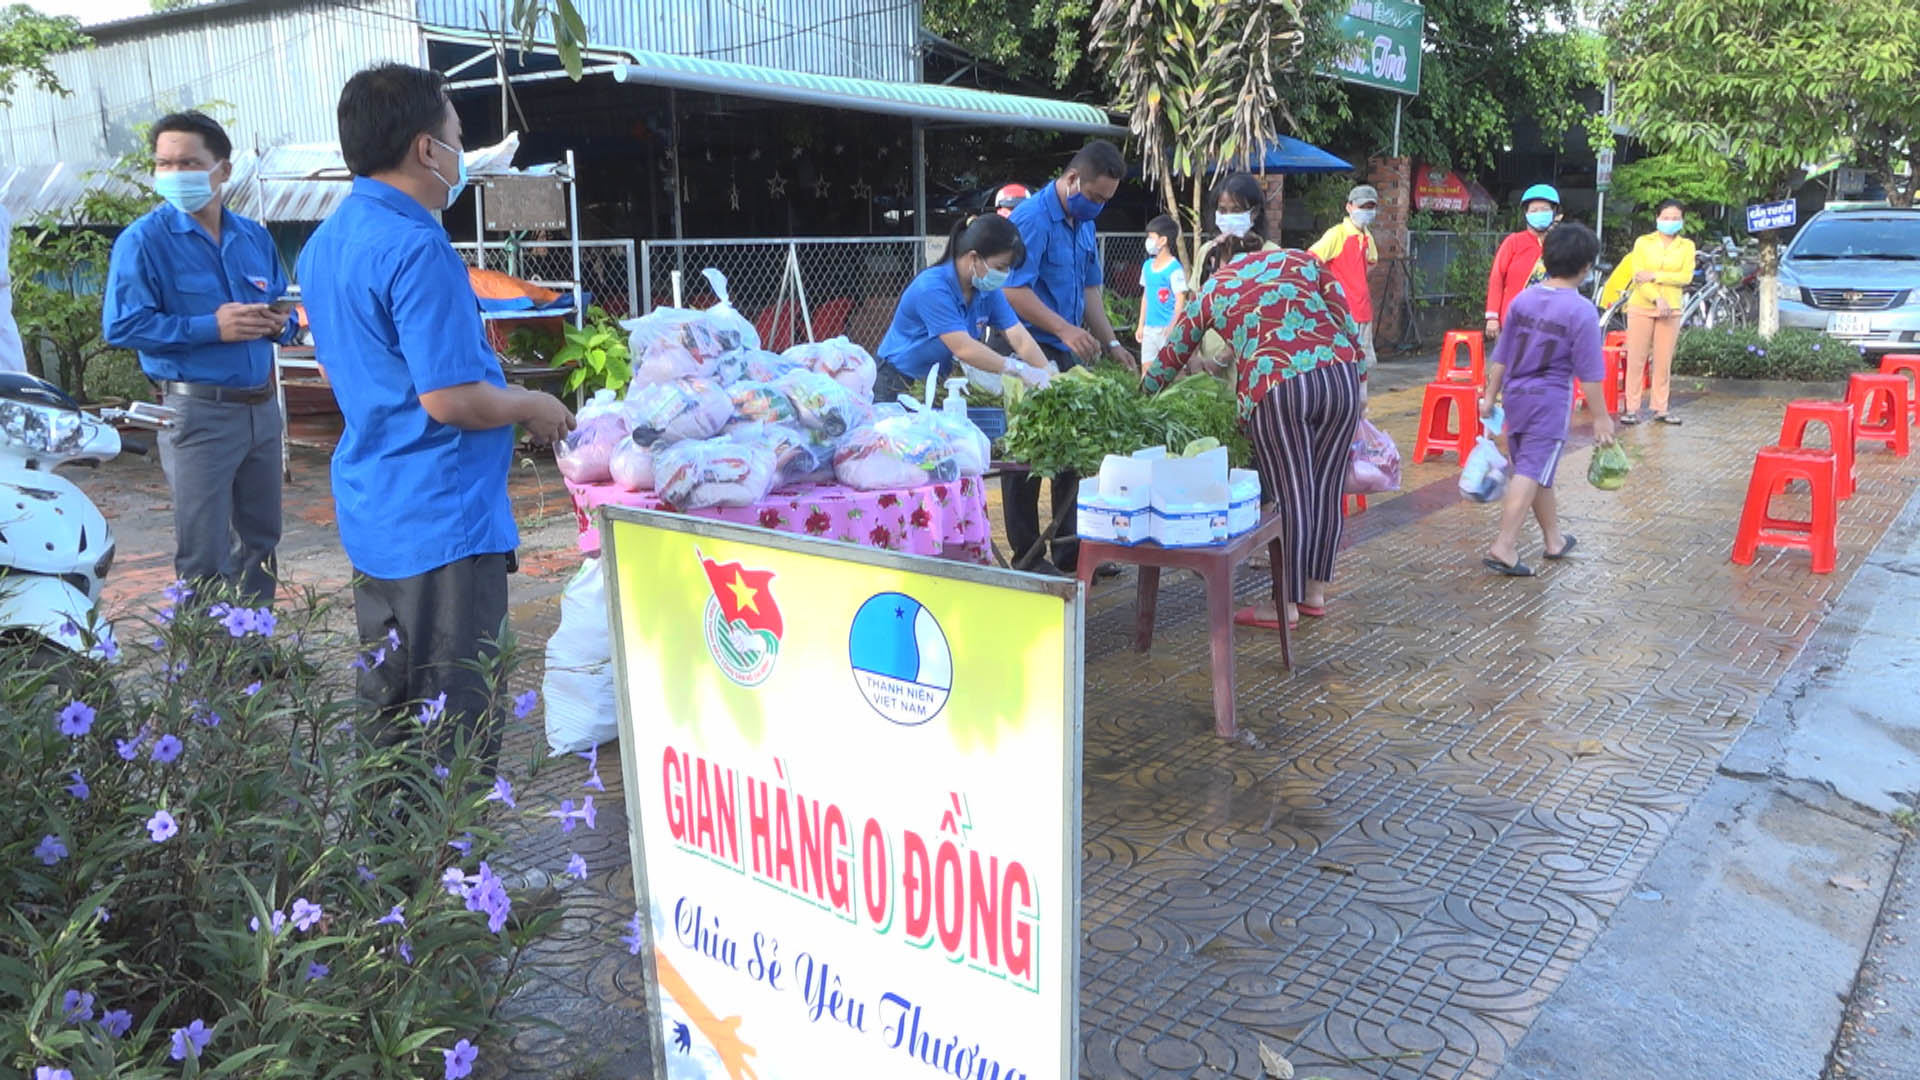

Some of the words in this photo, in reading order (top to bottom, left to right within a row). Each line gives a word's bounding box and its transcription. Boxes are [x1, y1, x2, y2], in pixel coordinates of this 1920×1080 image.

[866, 677, 903, 694] THANH
[907, 687, 935, 704] NIÊN
[901, 701, 926, 716] NAM
[663, 746, 741, 867] GIAN
[748, 757, 851, 914] HÀNG
[903, 792, 1033, 982] ĐỒNG
[675, 896, 740, 971] Chia
[748, 932, 784, 991] Sẻ
[794, 951, 867, 1033] Yêu
[879, 992, 1027, 1080] Thươn
